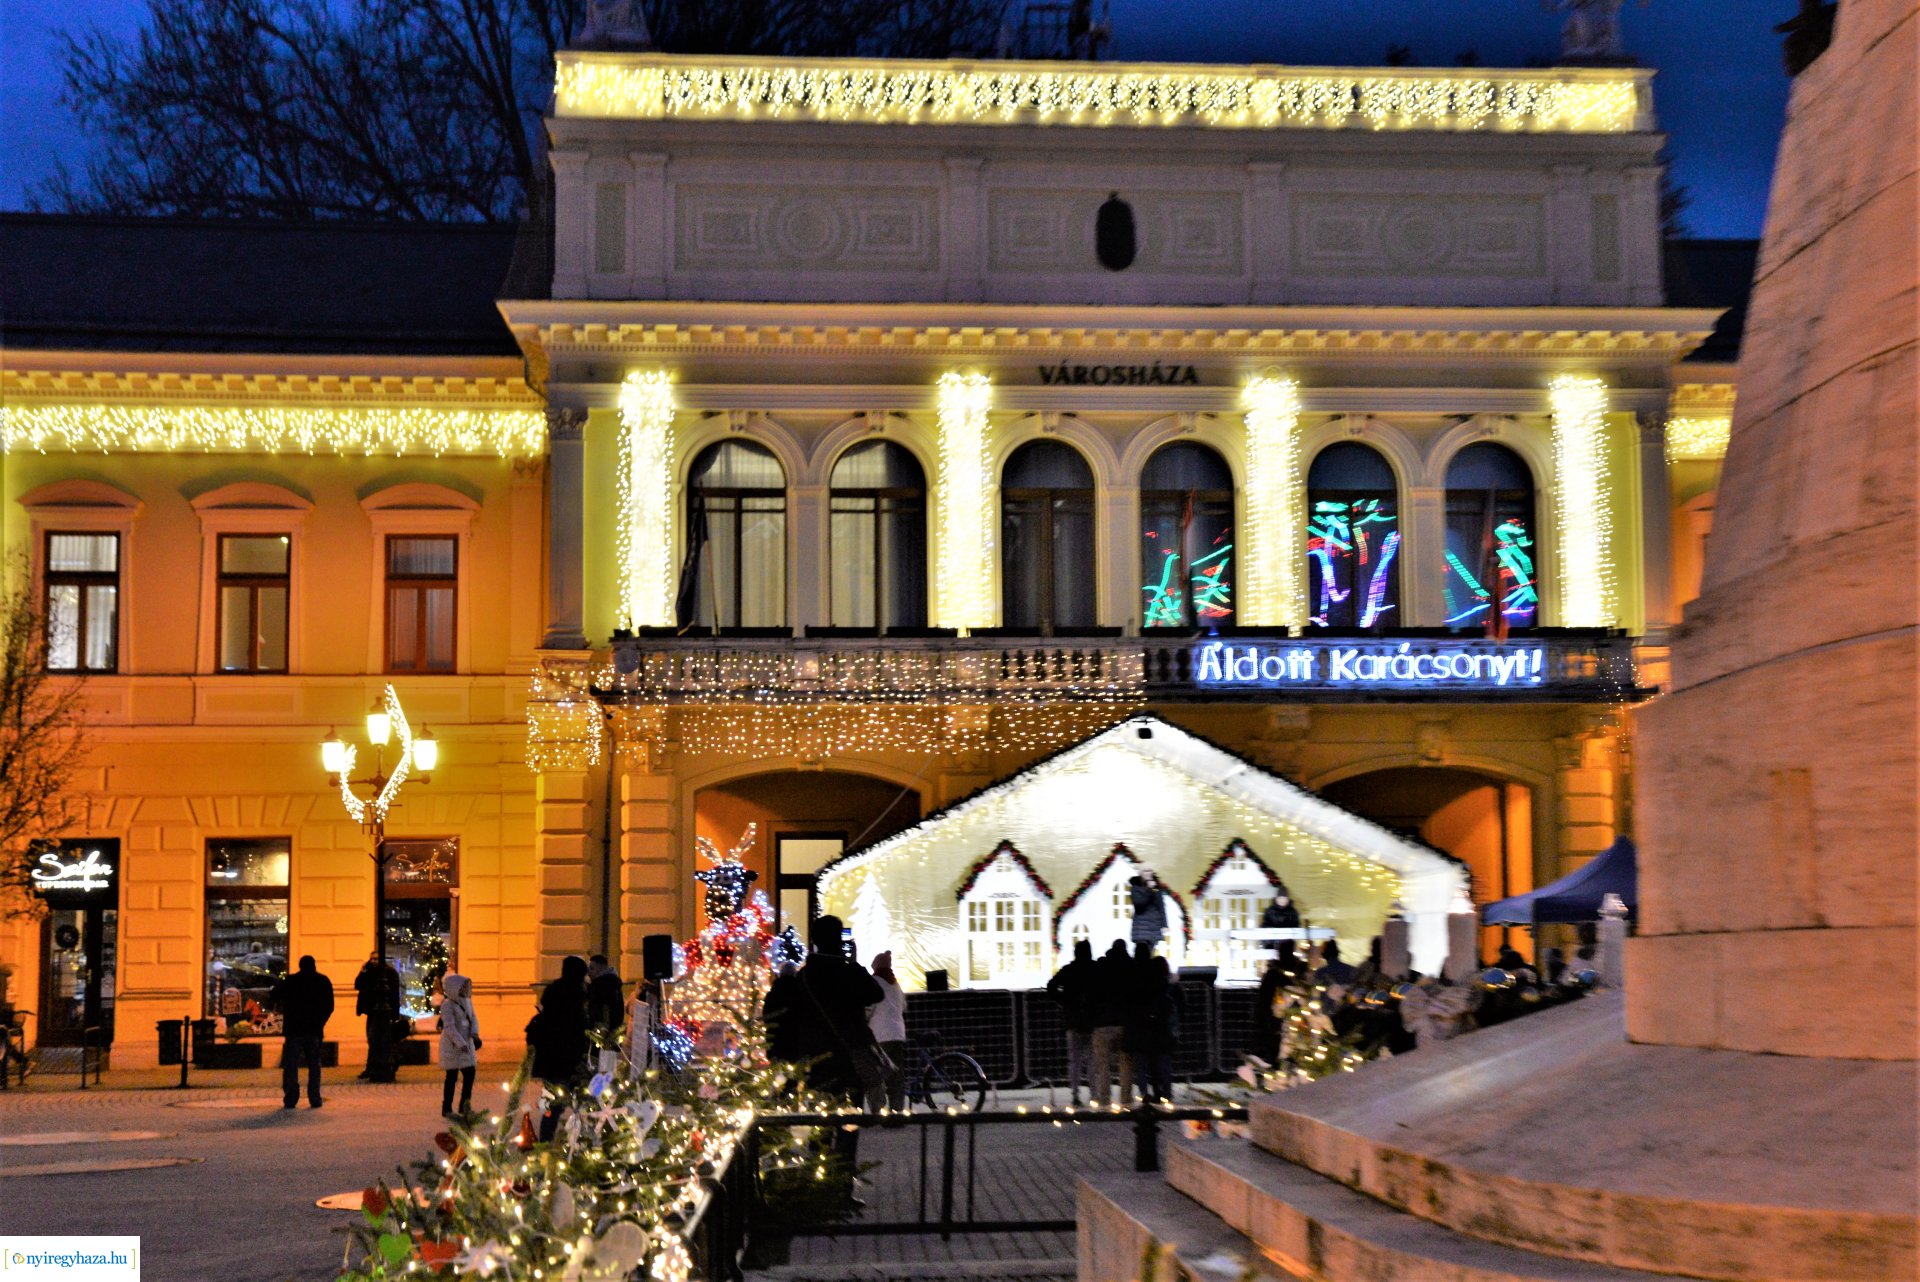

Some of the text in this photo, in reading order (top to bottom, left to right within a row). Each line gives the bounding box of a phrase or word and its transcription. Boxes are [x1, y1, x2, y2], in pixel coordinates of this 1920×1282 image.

[1038, 359, 1198, 386] VÁROSHÁZA
[1198, 641, 1543, 685] Áldott Karácsonyt!
